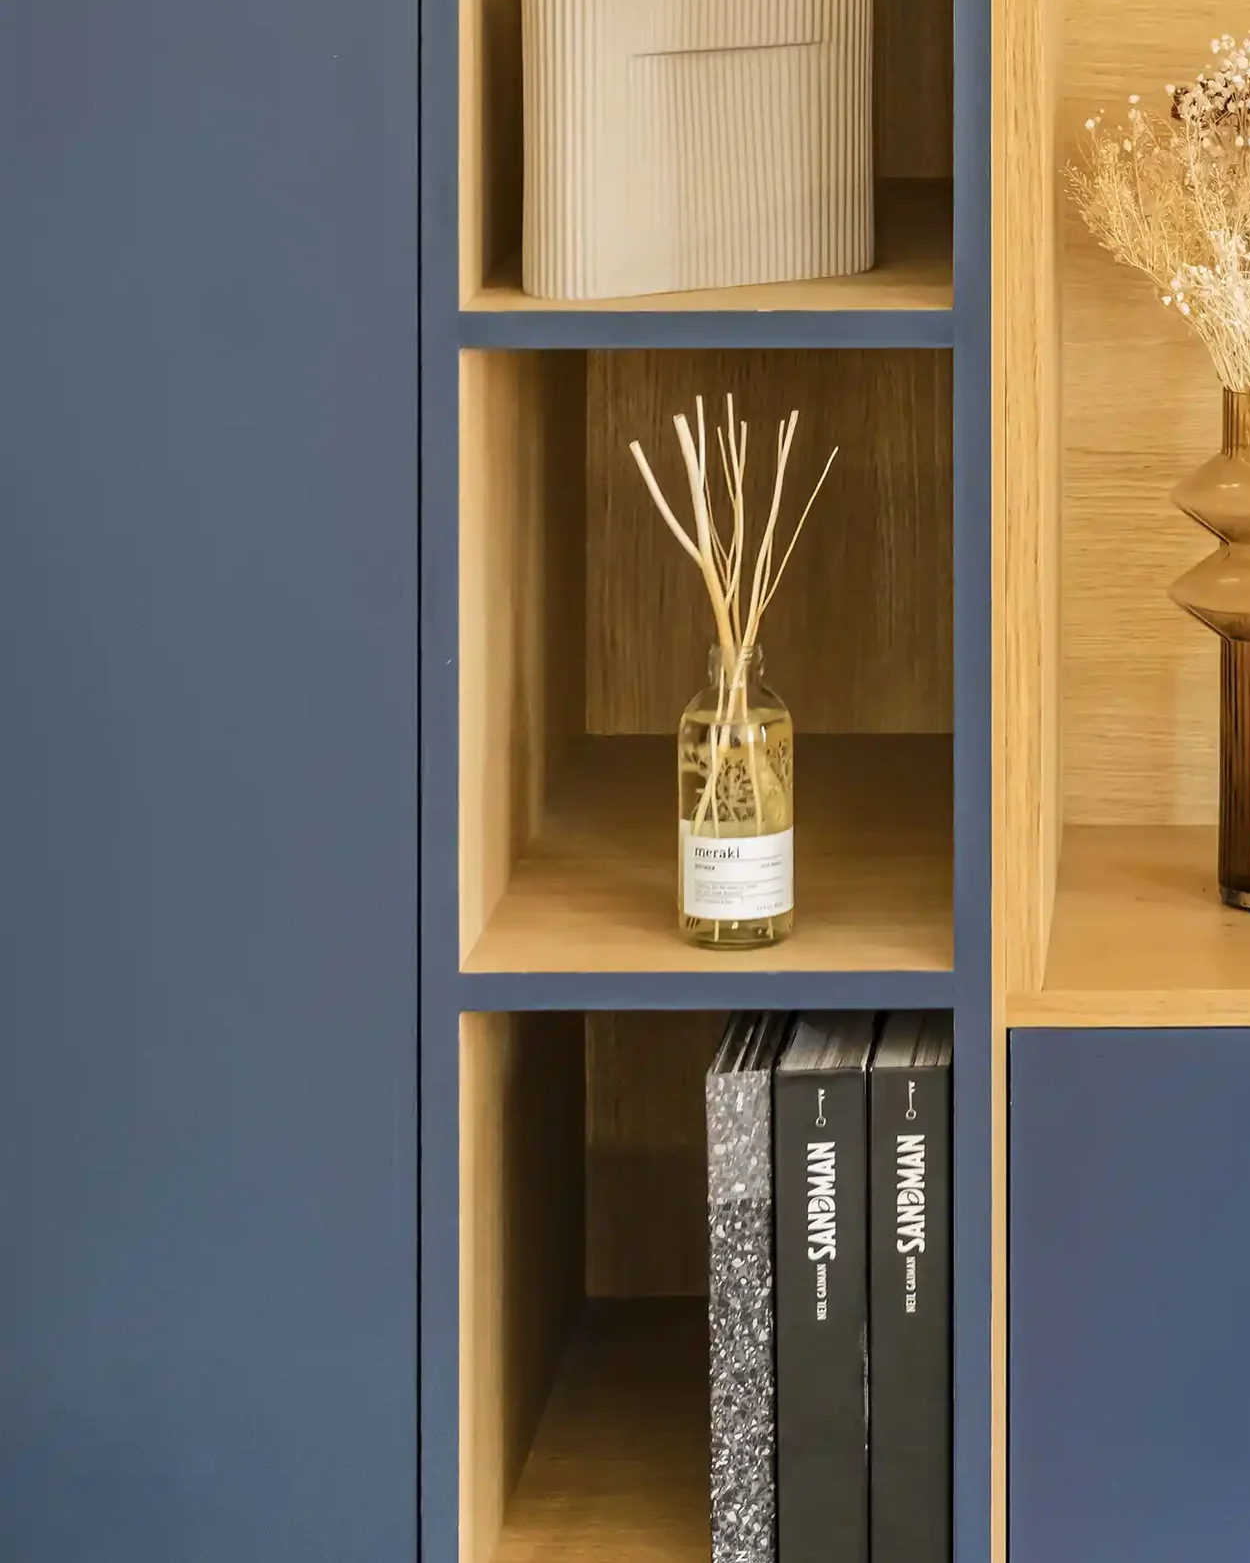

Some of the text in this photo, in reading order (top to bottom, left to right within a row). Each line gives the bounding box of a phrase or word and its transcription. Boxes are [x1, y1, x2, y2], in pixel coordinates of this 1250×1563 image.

[694, 845, 740, 859] meraki
[807, 1141, 837, 1320] NEIL GAIMAN SANDMAN
[896, 1134, 925, 1313] NEIL GAIMAN SANDMAN
